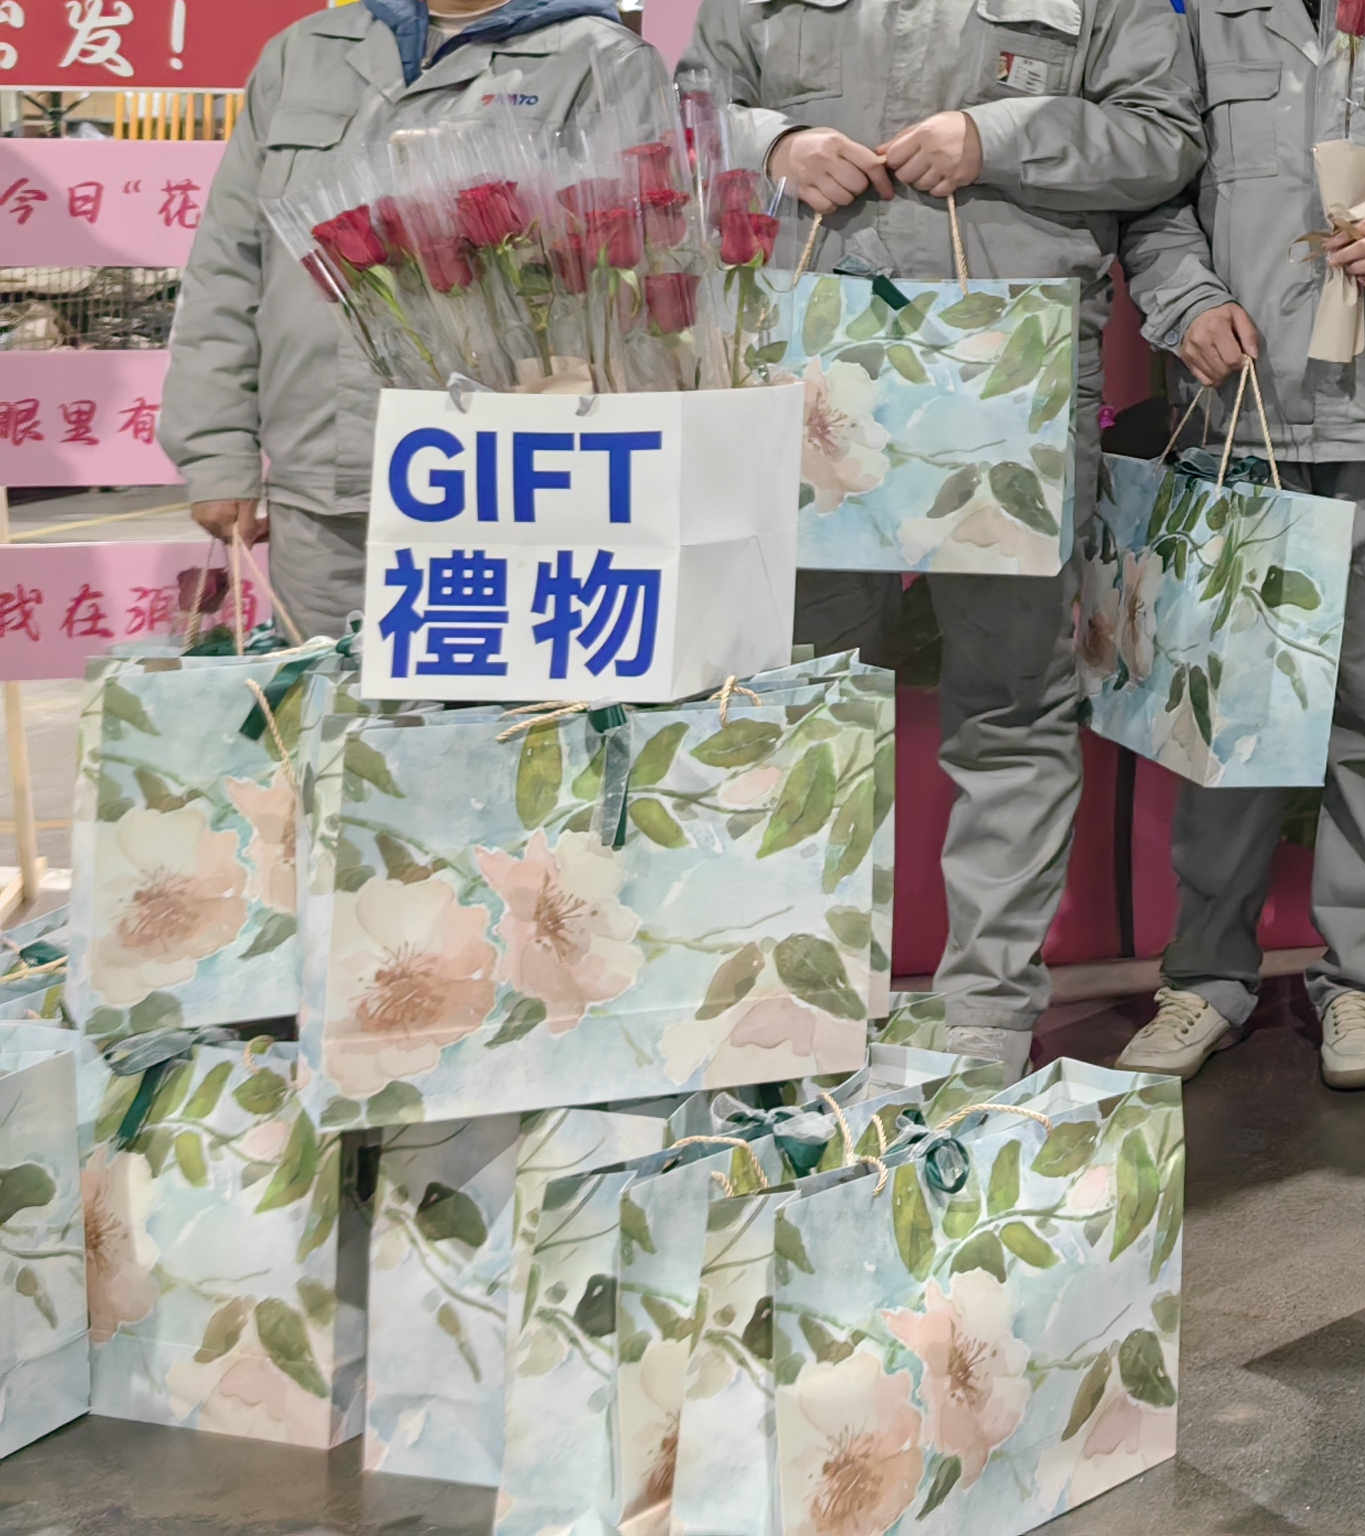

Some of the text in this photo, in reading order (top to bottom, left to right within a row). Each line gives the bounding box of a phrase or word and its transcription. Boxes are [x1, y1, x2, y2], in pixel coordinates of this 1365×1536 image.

[0, 397, 161, 446] 眼里有
[387, 426, 663, 525] GIFT
[378, 547, 663, 681] 禮物
